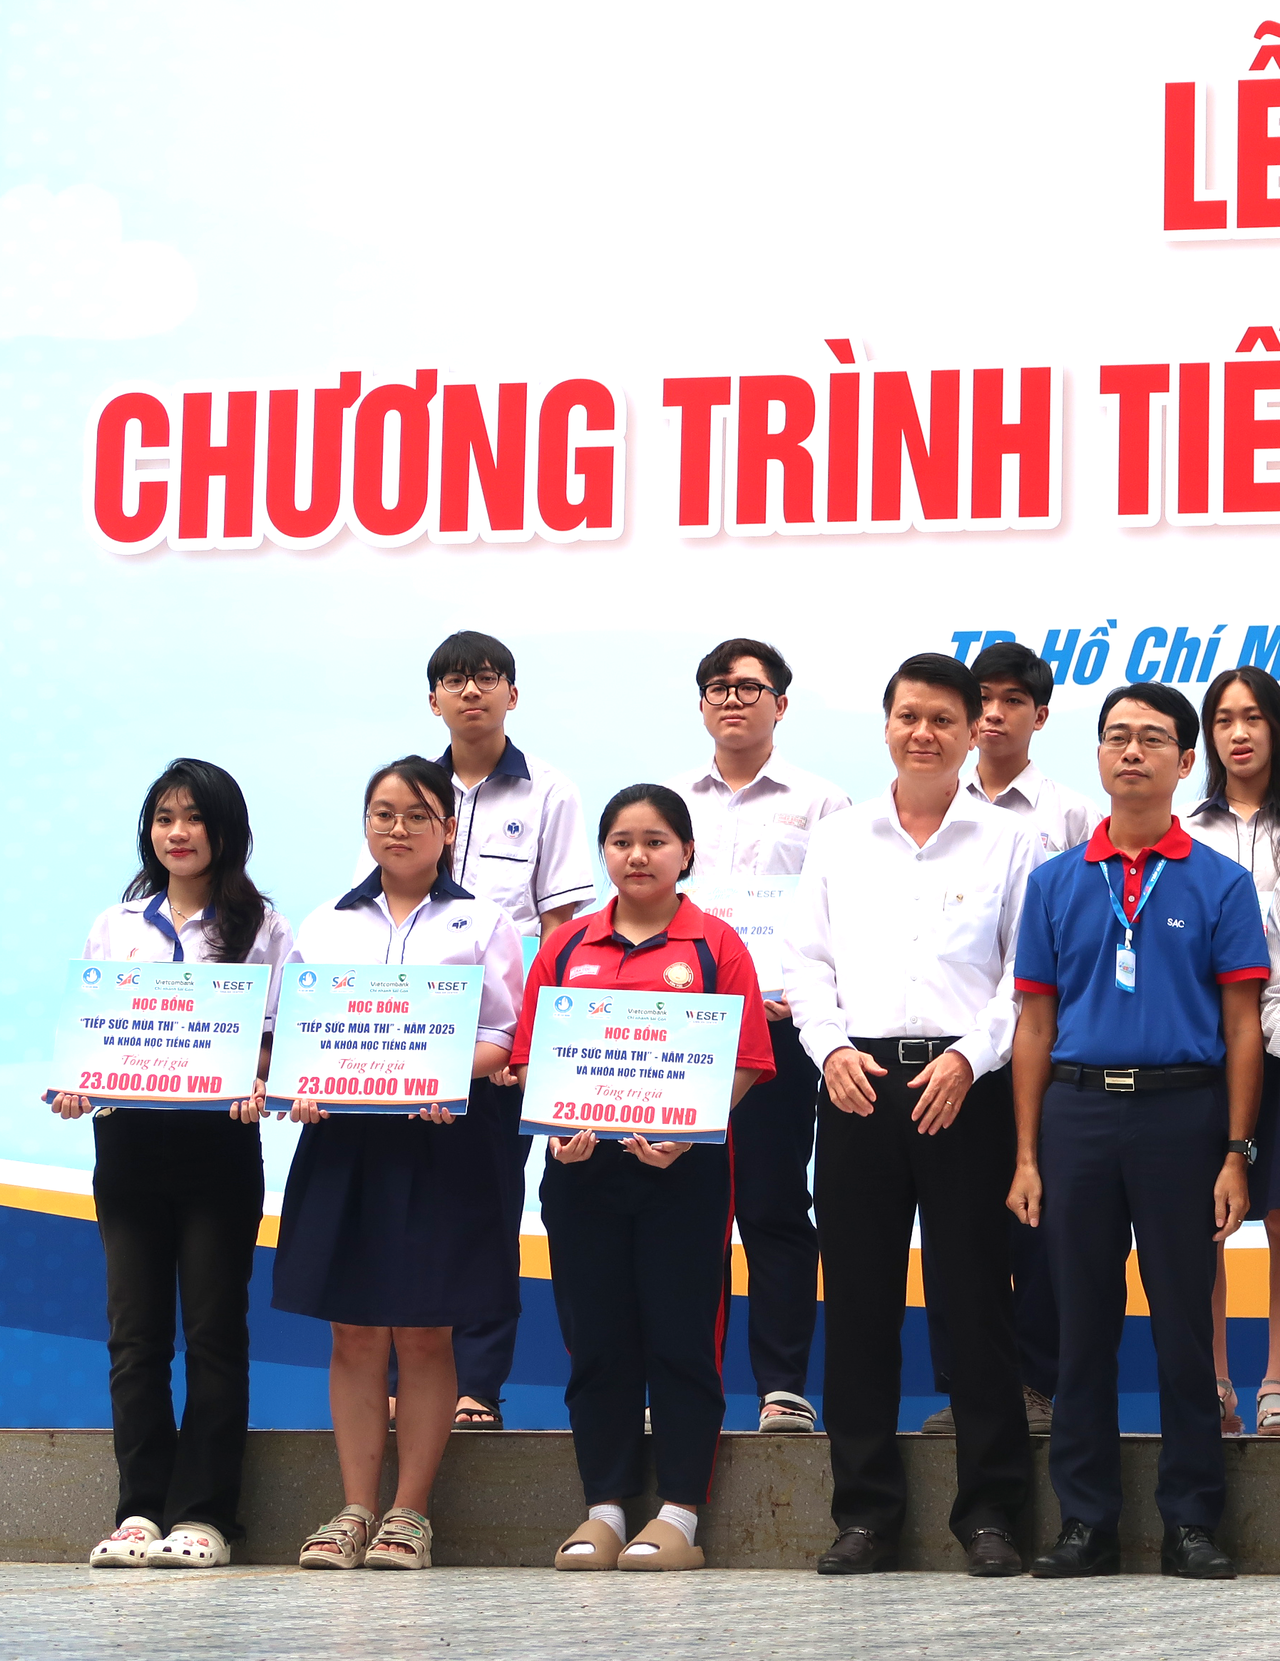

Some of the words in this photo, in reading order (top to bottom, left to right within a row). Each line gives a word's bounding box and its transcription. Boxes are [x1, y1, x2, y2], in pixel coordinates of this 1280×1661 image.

[94, 368, 616, 543] CHƯƠNG
[662, 338, 1053, 526] TRÌNH
[1041, 618, 1118, 686] Hồ
[1125, 624, 1228, 684] Chí
[751, 926, 773, 935] 2025
[1167, 918, 1185, 928] SAC
[132, 998, 157, 1012] HỌC
[161, 995, 194, 1012] BỔNG
[348, 1001, 372, 1015] HỌC
[376, 997, 409, 1013] BỔNG
[108, 1017, 129, 1030] SỨC
[132, 1019, 154, 1031] MÙA
[188, 1021, 210, 1032] NĂM
[213, 1023, 239, 1033] 2025
[325, 1022, 345, 1033] SỨC
[348, 1022, 370, 1033] MÙA
[404, 1022, 426, 1034] NĂM
[429, 1024, 455, 1034] 2025
[604, 1027, 630, 1042] HỌC
[634, 1025, 667, 1041] BỔNG
[103, 1035, 115, 1045] VÀ
[118, 1037, 141, 1046] KHÓA
[144, 1038, 163, 1049] HỌC
[166, 1037, 190, 1048] TIẾNG
[193, 1040, 211, 1049] ANH
[320, 1040, 331, 1049] VÀ
[334, 1040, 358, 1050] KHÓA
[361, 1041, 379, 1052] HỌC
[382, 1039, 406, 1050] TIẾNG
[409, 1042, 427, 1050] ANH
[581, 1046, 602, 1059] SỨC
[605, 1049, 627, 1061] MÙA
[662, 1051, 684, 1063] NĂM
[687, 1053, 714, 1064] 2025
[576, 1065, 588, 1075] VÀ
[590, 1066, 615, 1077] KHÓA
[617, 1068, 636, 1079] HỌC
[639, 1067, 664, 1079] TIẾNG
[667, 1070, 685, 1080] ANH
[79, 1072, 181, 1092] 23.000.000
[187, 1076, 222, 1093] VNĐ
[297, 1077, 398, 1096] 23.000.000
[404, 1078, 439, 1096] VNĐ
[553, 1101, 656, 1124] 23.000.000
[662, 1107, 697, 1126] VNĐ
